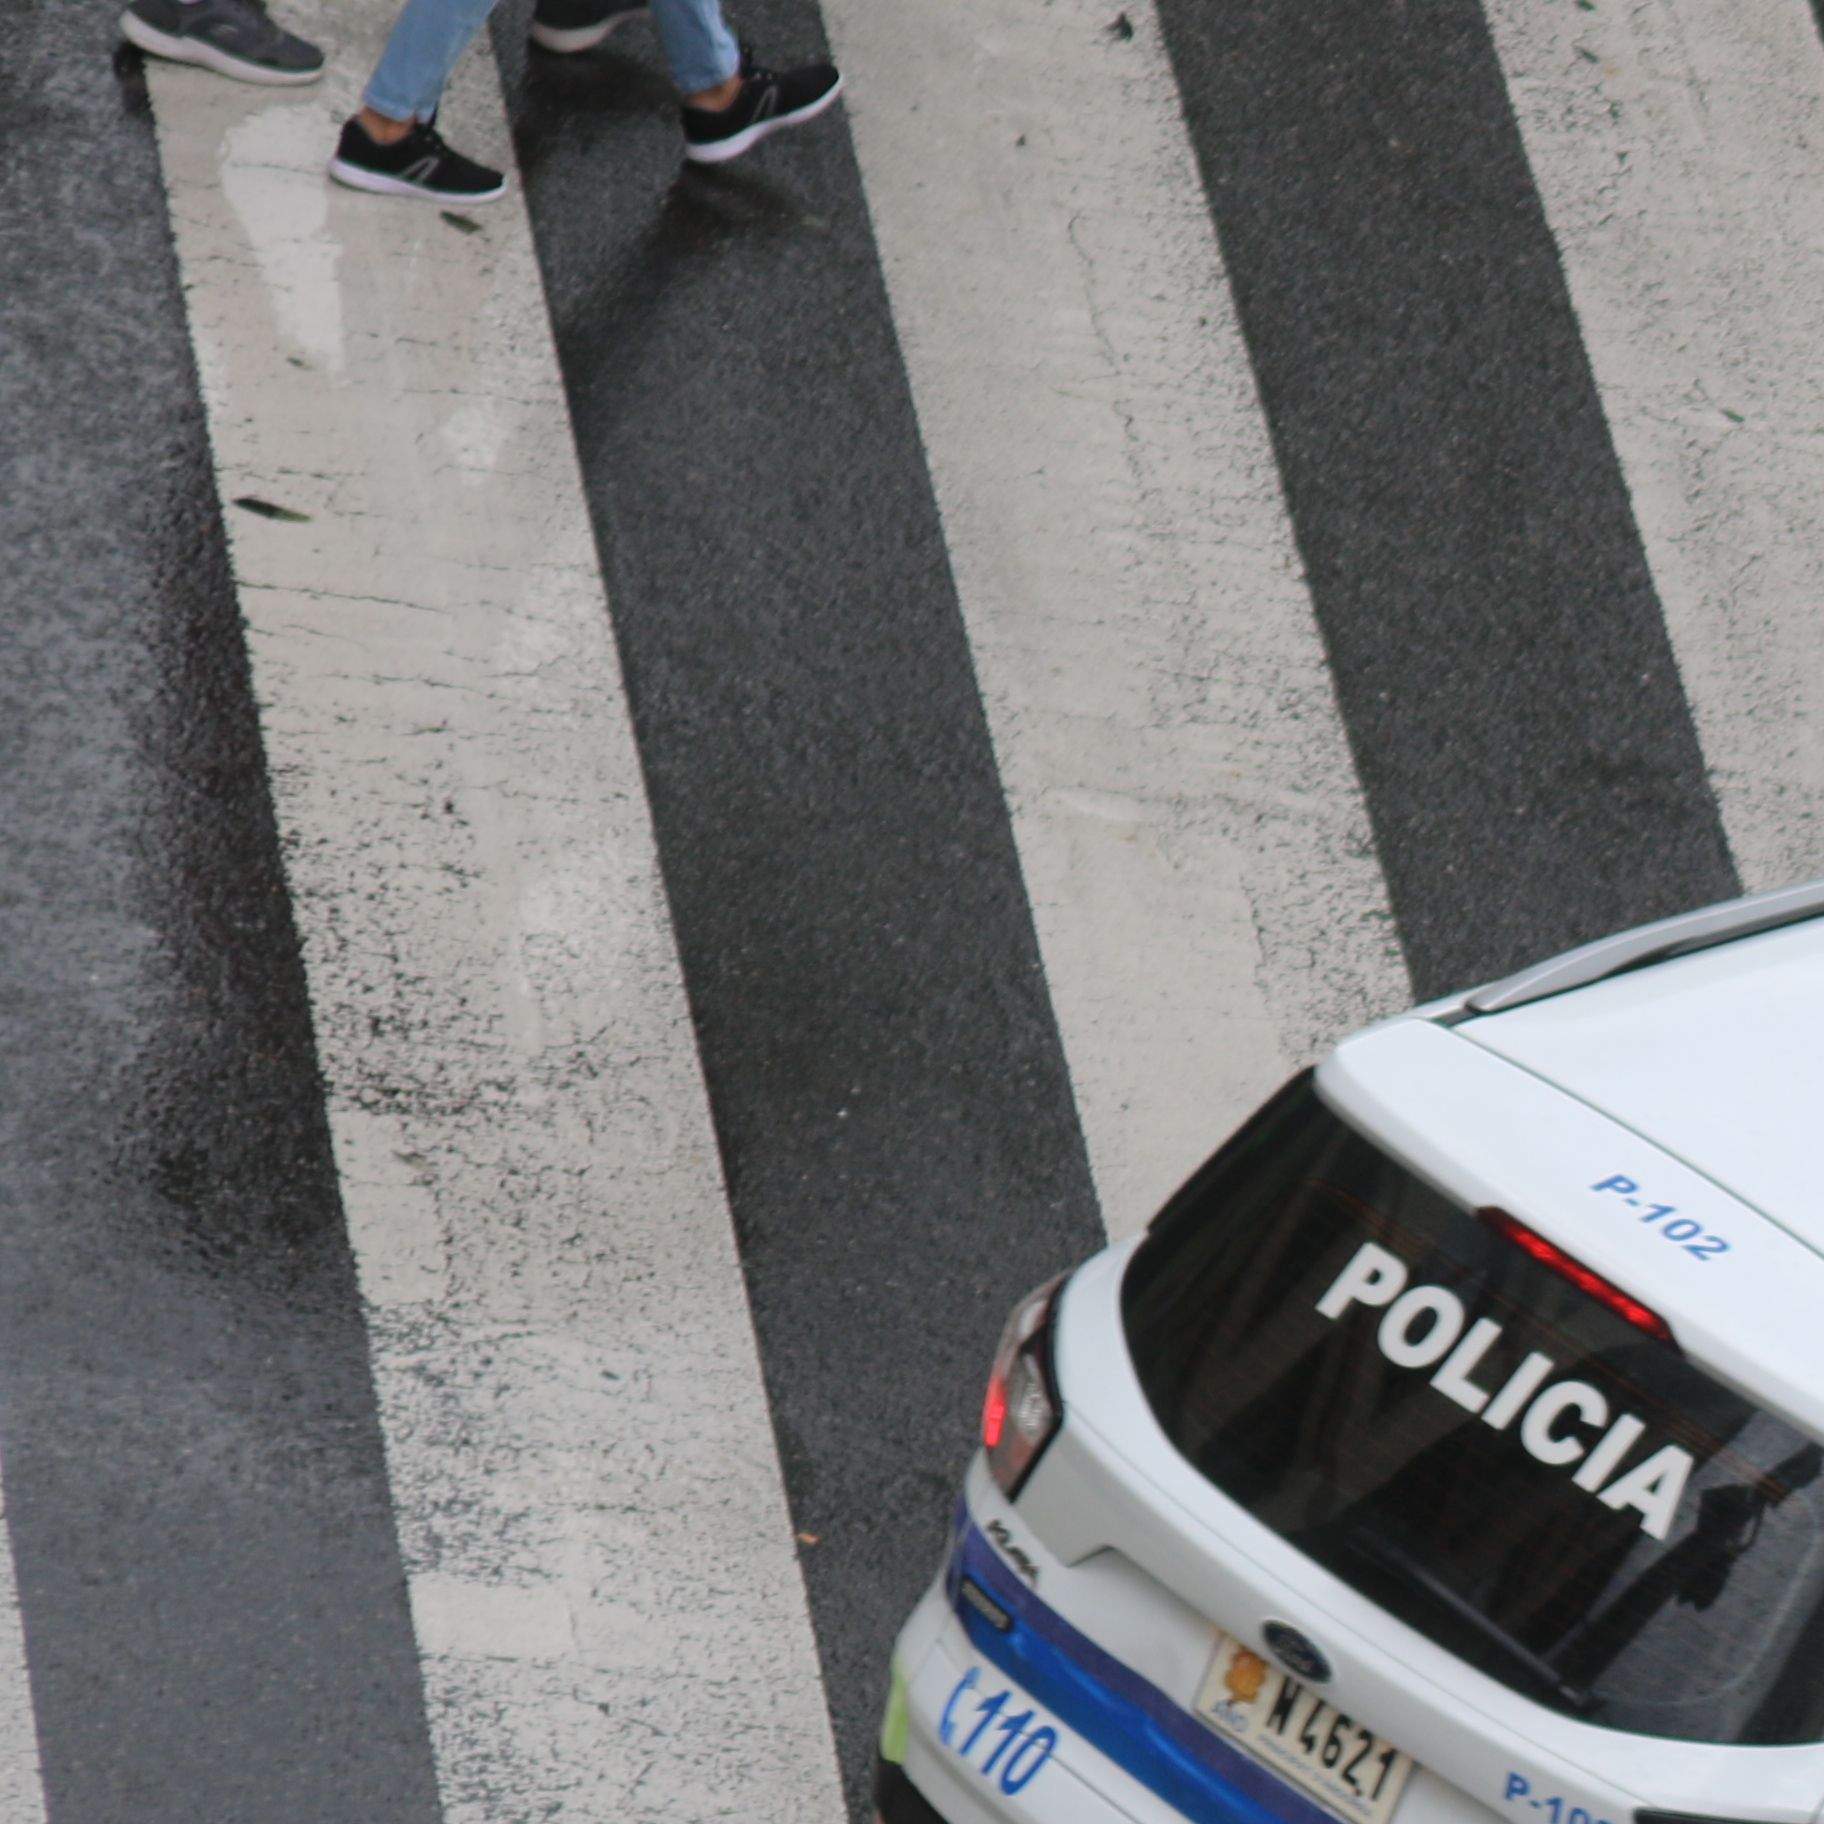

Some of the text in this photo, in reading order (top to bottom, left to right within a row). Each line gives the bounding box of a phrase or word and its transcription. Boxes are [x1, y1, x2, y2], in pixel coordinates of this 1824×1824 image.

[1589, 1173, 1734, 1262] P-102
[1316, 1241, 1694, 1541] POLICIA
[960, 1690, 1062, 1798] 110
